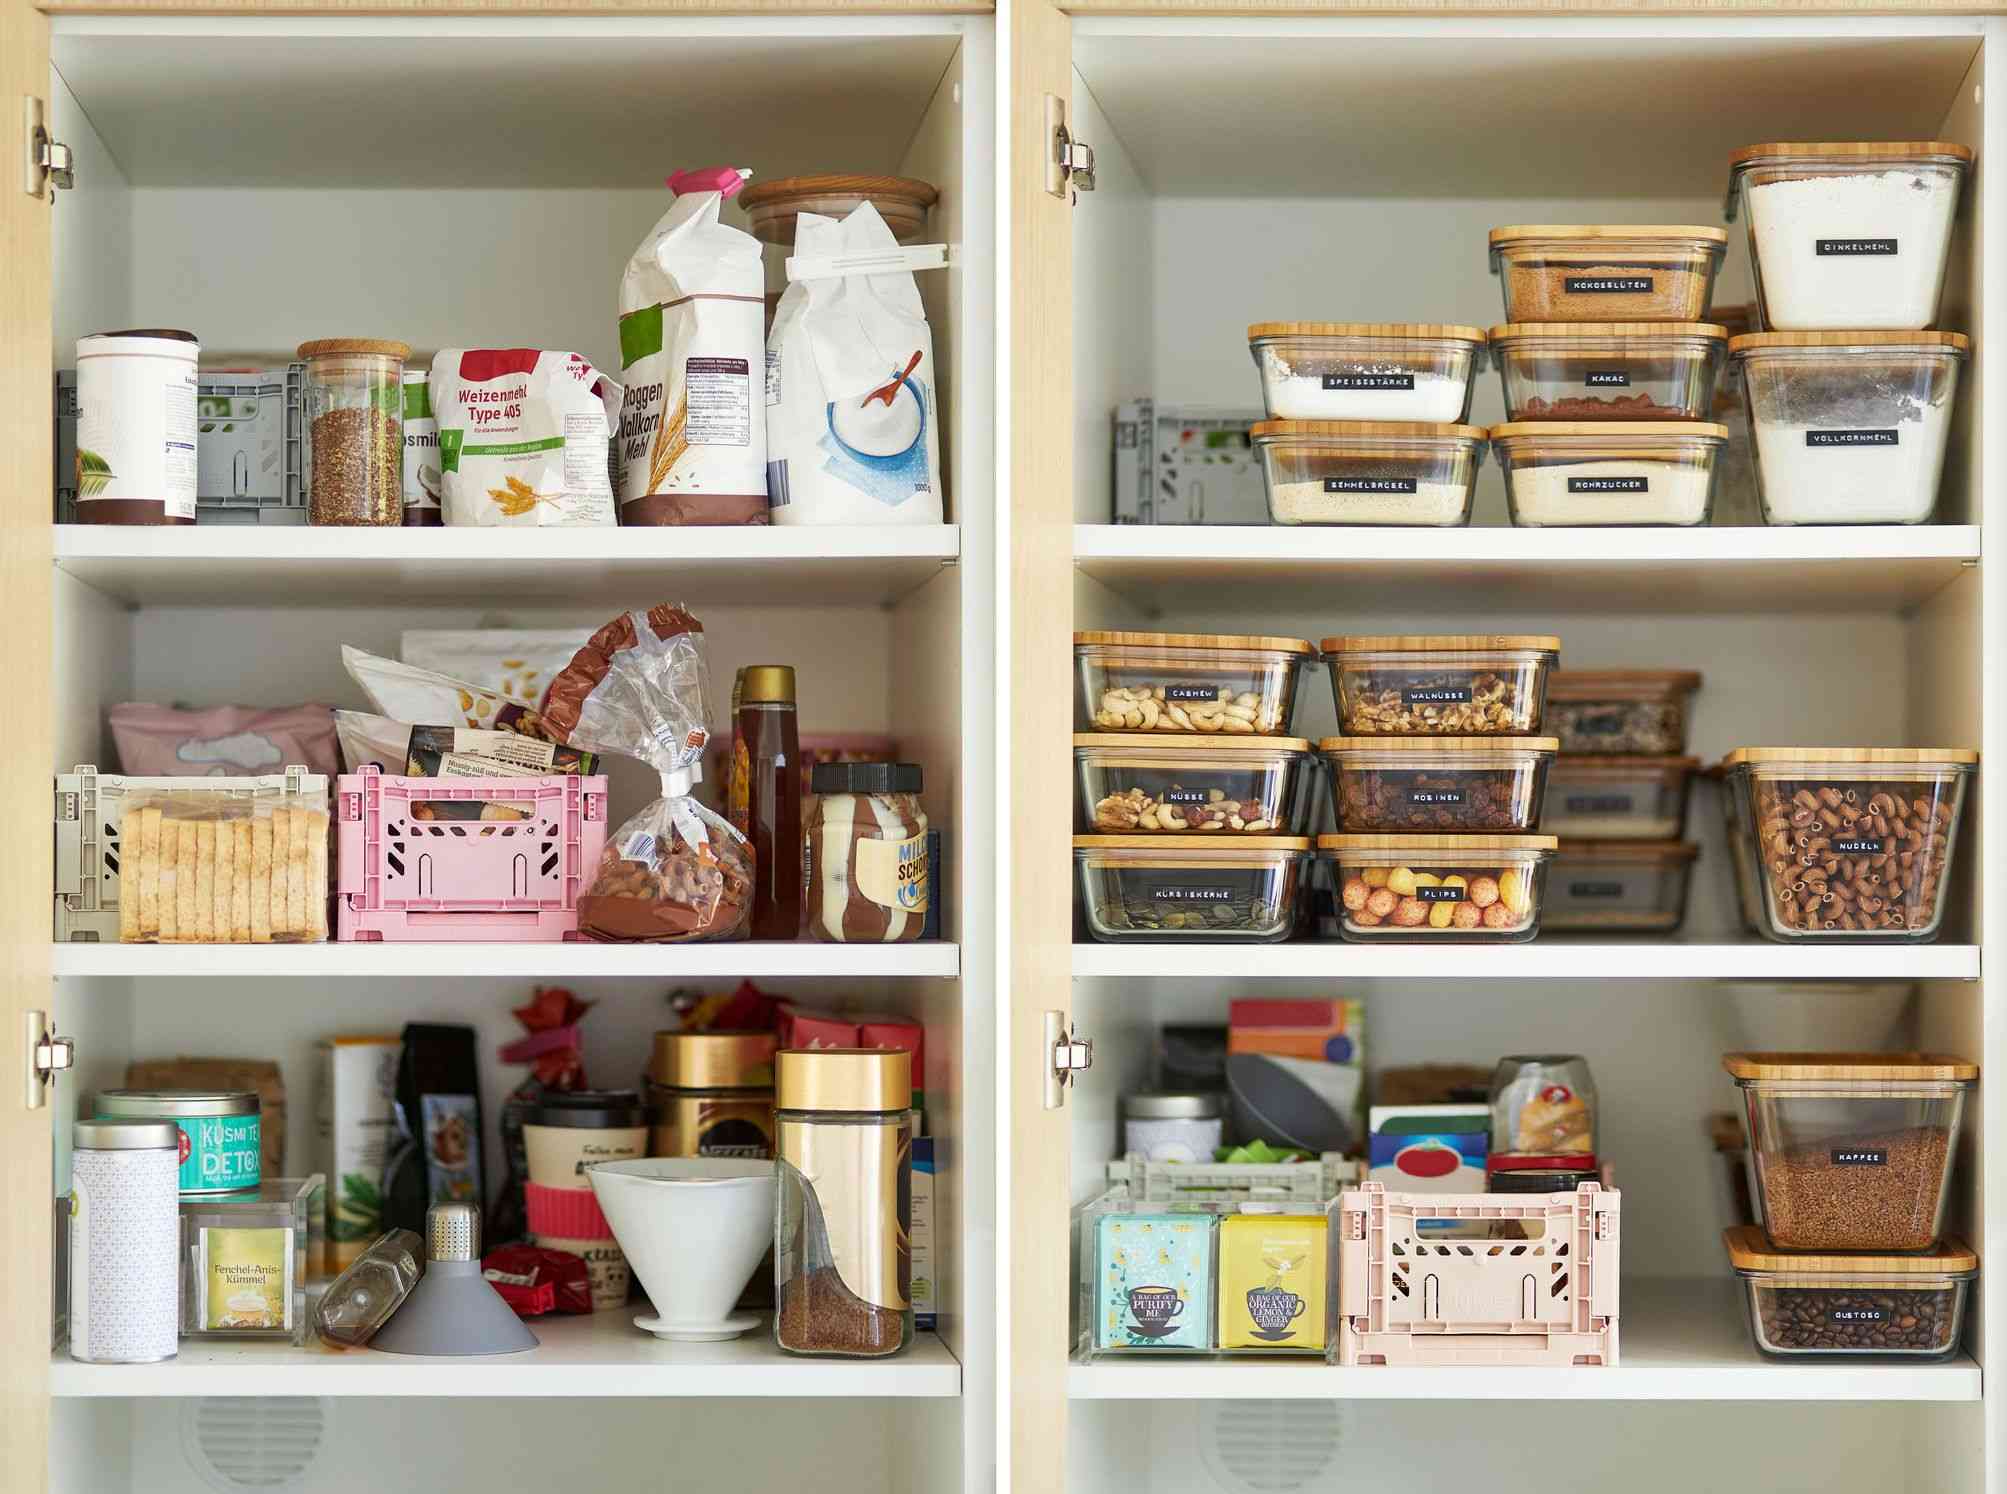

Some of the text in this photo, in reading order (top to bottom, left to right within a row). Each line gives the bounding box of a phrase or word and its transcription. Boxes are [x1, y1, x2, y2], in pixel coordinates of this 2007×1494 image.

[1823, 243, 1891, 251] DINKELMEHL
[1591, 375, 1625, 383] KAKAO
[459, 383, 527, 404] Weizenmehl
[623, 383, 662, 411] Roggen
[468, 404, 521, 424] Type 405
[619, 413, 659, 439] Vollkorn
[1813, 433, 1893, 442] VOLLKORNMEHL
[625, 434, 650, 462] Mehl
[1575, 481, 1641, 489] ROHRZUCKER
[1172, 689, 1213, 697] CASHEW
[1410, 691, 1464, 699] WALNÜSSE
[1170, 791, 1204, 801] NÜSSE
[1839, 842, 1879, 850] NUDELN
[1424, 890, 1457, 898] FLIPS
[202, 1124, 246, 1149] KUSMI
[214, 1263, 281, 1274] Fenchel-Anis-
[1133, 1300, 1173, 1310] PURIFY
[1249, 1299, 1296, 1309] ORGANIC
[1146, 1309, 1160, 1317] ME
[1254, 1308, 1284, 1316] LEMON
[1835, 1311, 1880, 1319] GUSTOSO
